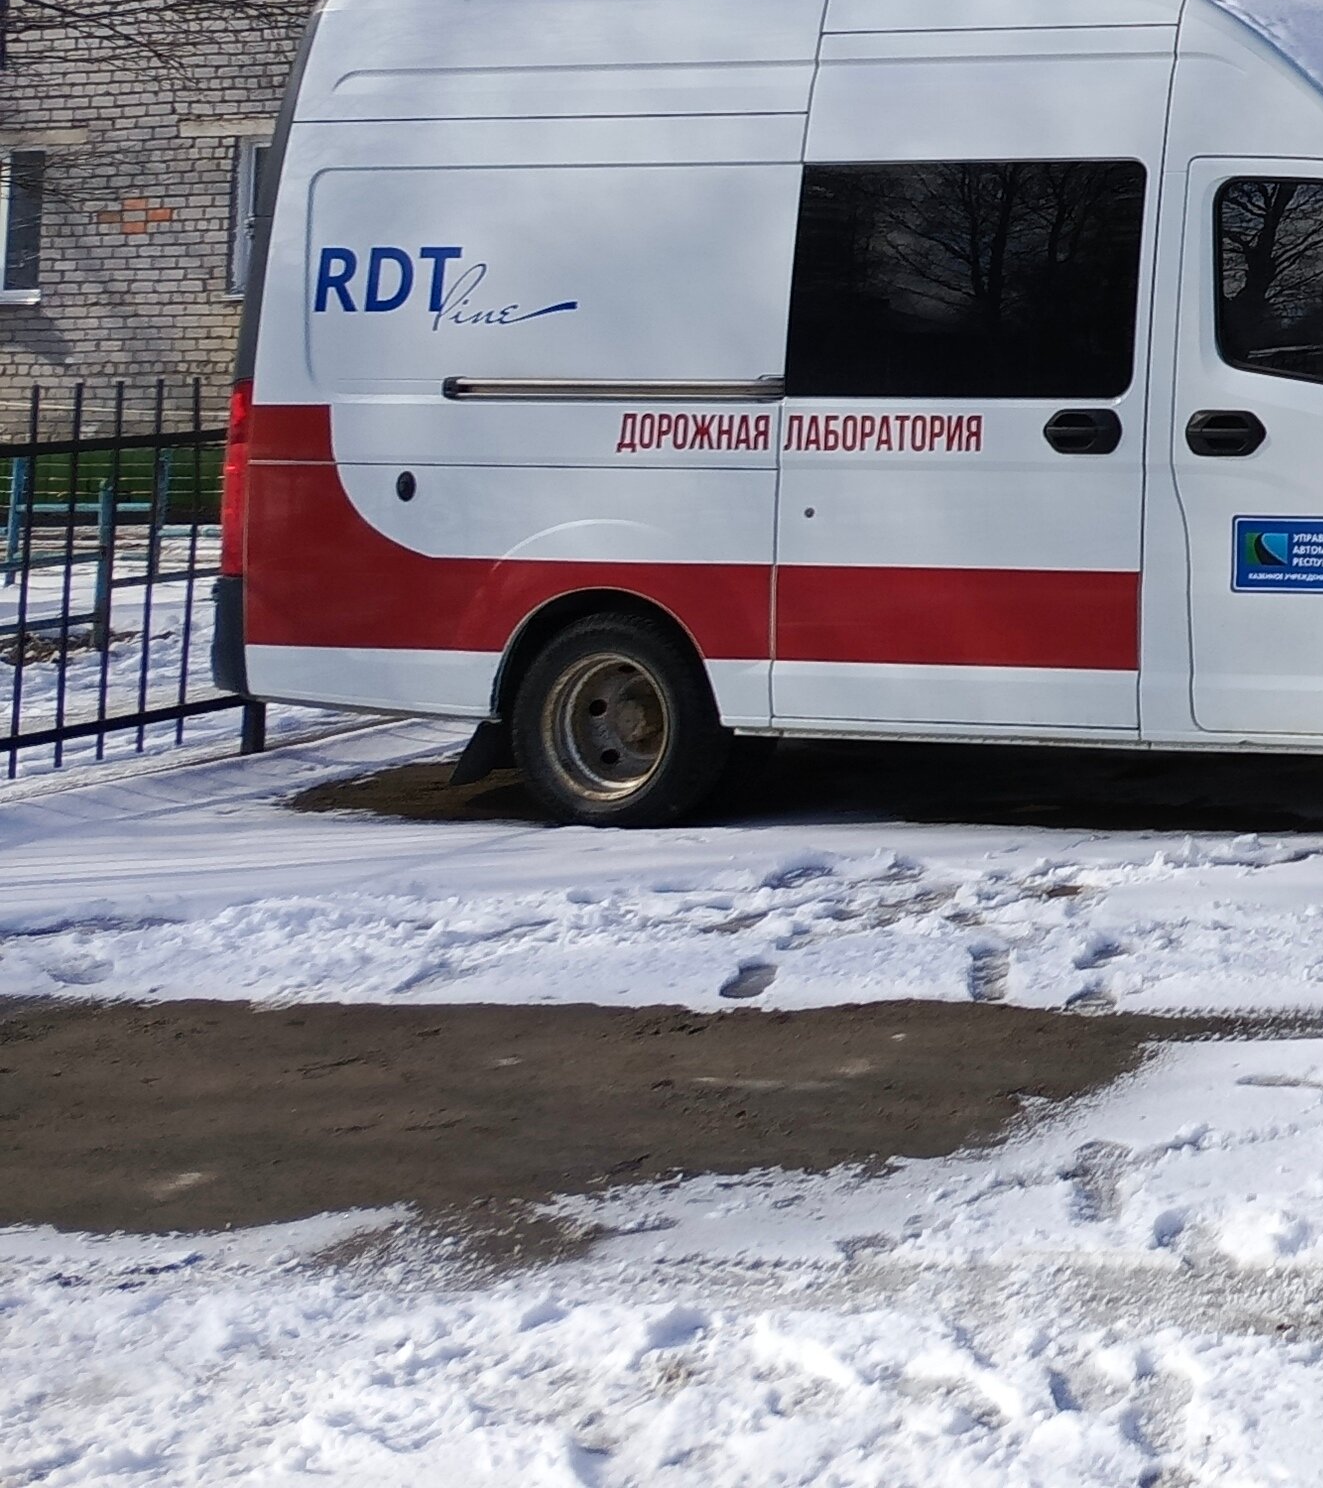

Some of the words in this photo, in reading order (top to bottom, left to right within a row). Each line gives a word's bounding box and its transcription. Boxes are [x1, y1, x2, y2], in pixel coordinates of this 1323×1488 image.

[314, 246, 463, 313] RDT
[432, 263, 577, 331] line
[616, 413, 771, 453] ДОРОЖНАЯ
[783, 414, 983, 452] ЛАБОРАТОРИЯ
